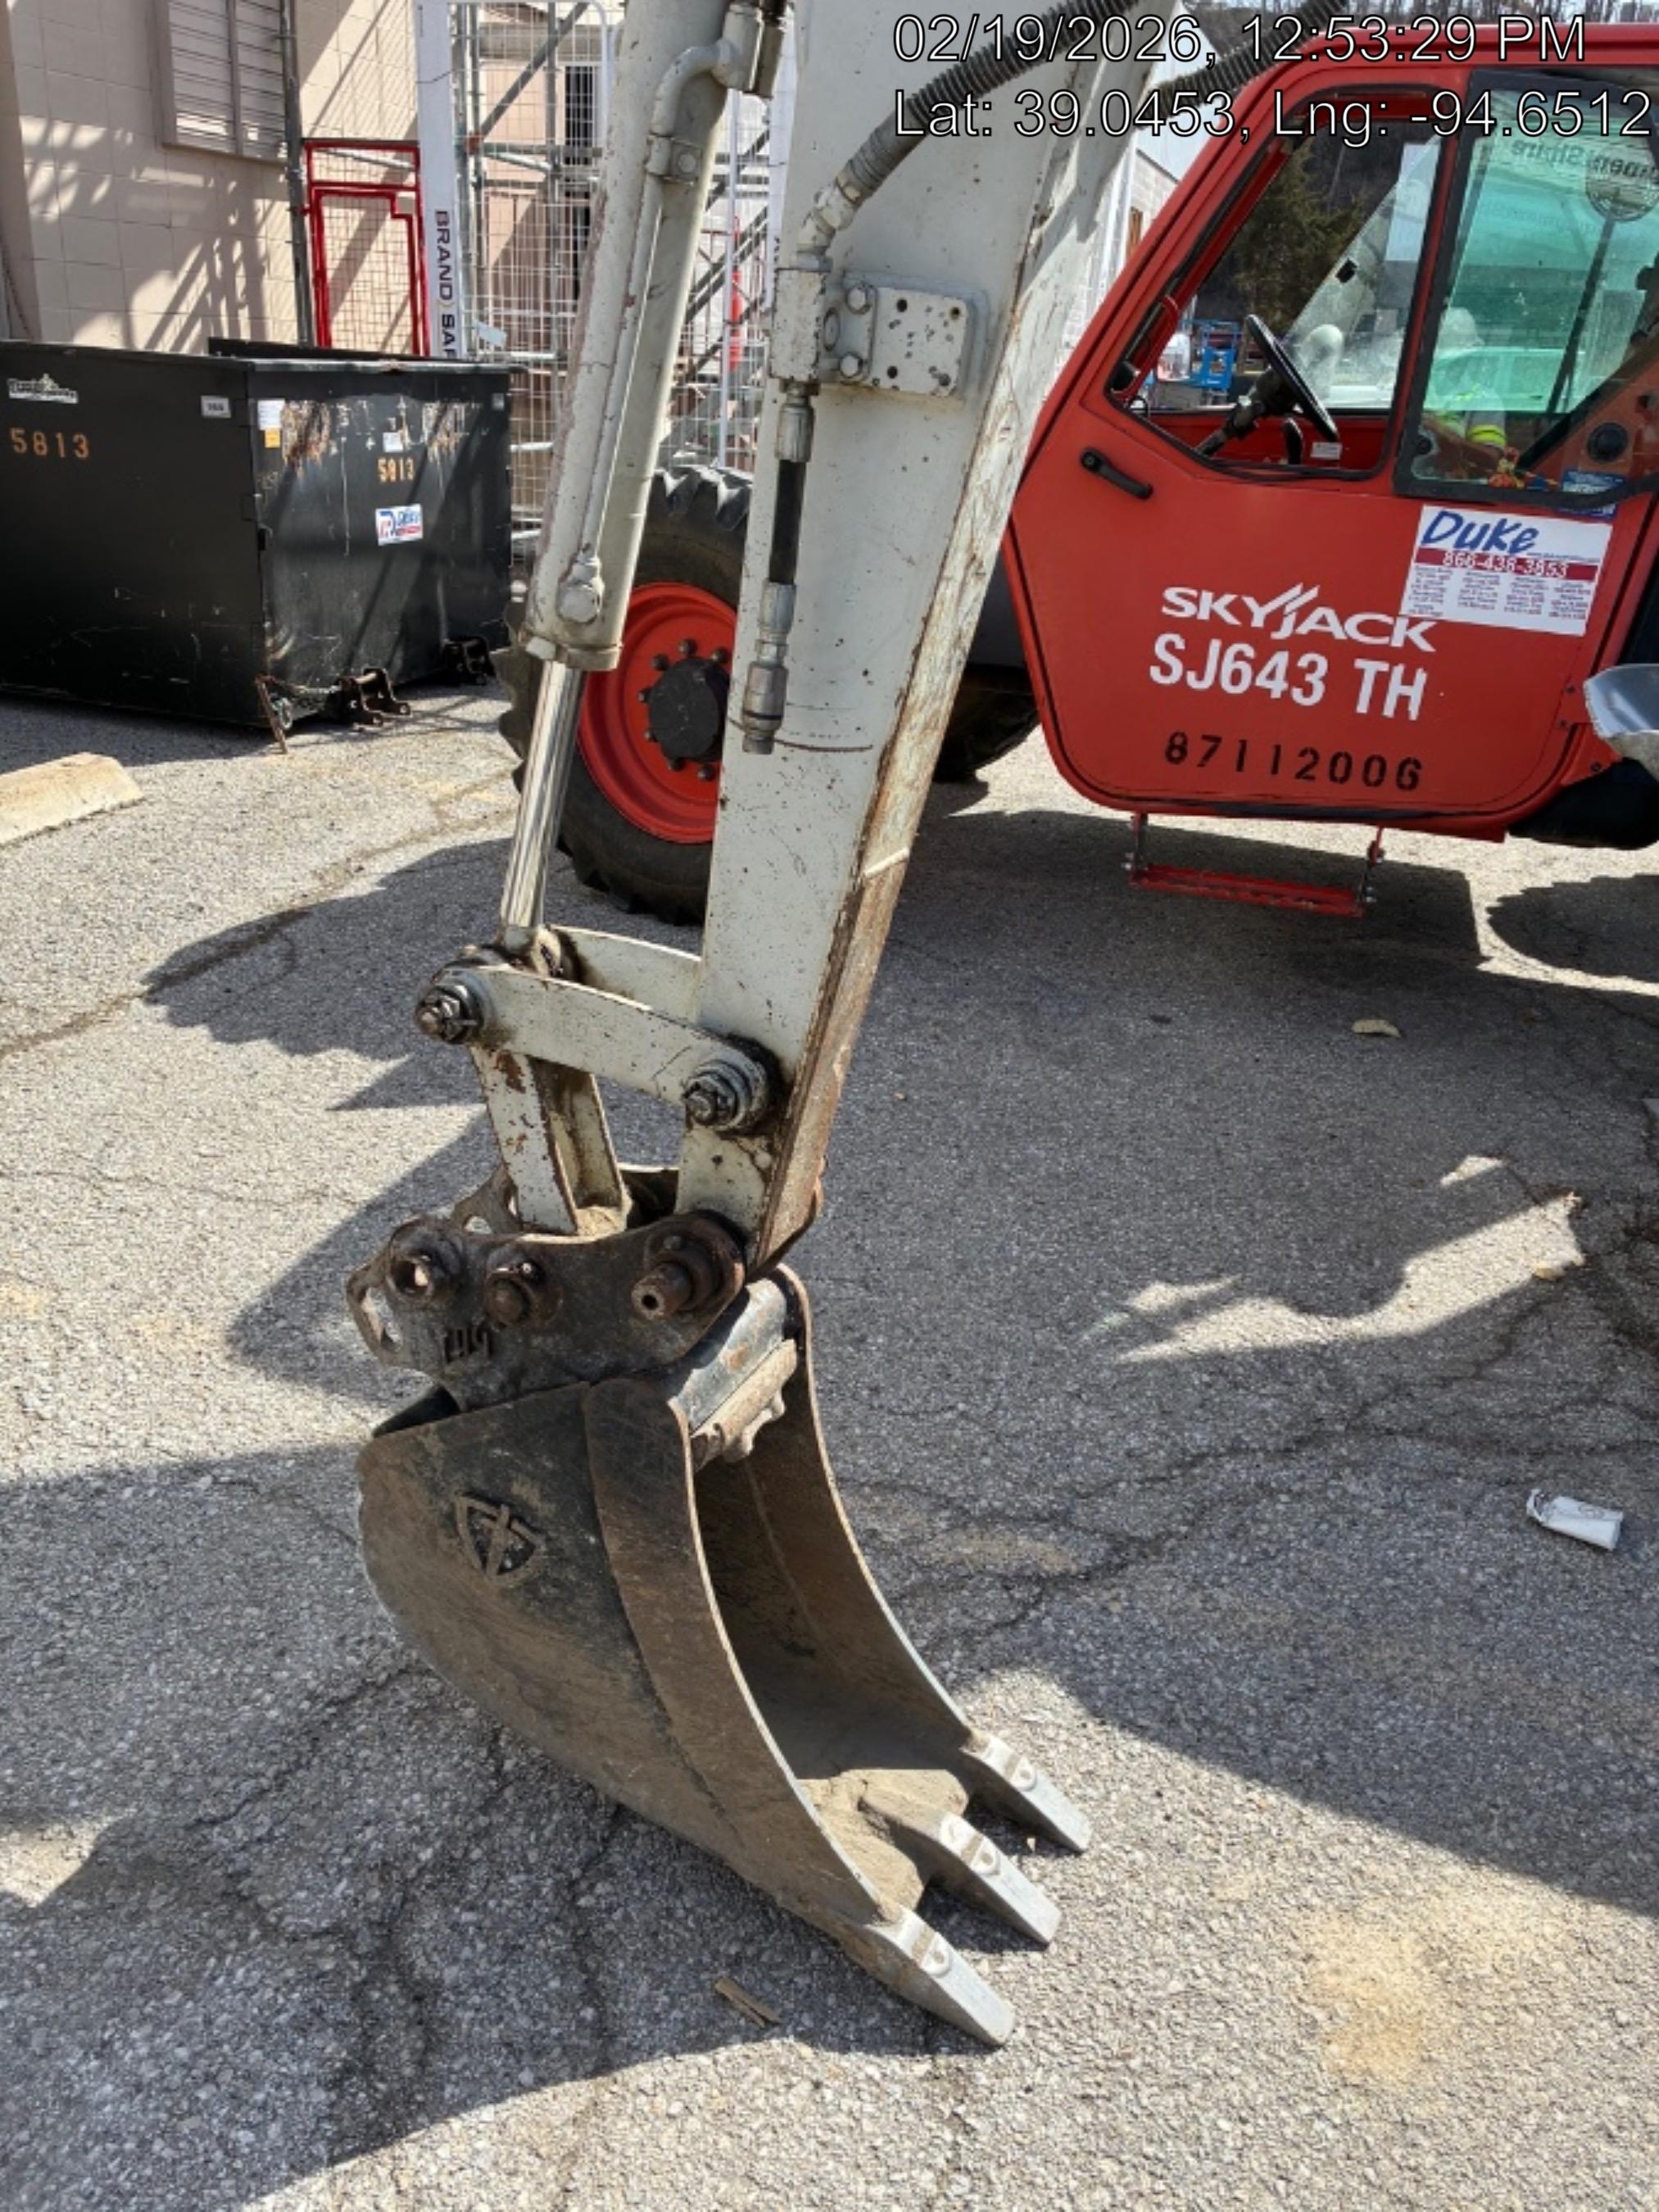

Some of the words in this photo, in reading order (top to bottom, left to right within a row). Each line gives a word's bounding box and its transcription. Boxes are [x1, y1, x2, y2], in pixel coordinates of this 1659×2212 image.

[435, 210, 453, 301] BRAND
[9, 427, 90, 460] 5813
[377, 457, 415, 483] 5813
[1162, 582, 1437, 652] SKYJACK
[1149, 632, 1329, 707] SJ643
[1353, 658, 1428, 721] TH
[1164, 731, 1423, 791] 87112006
